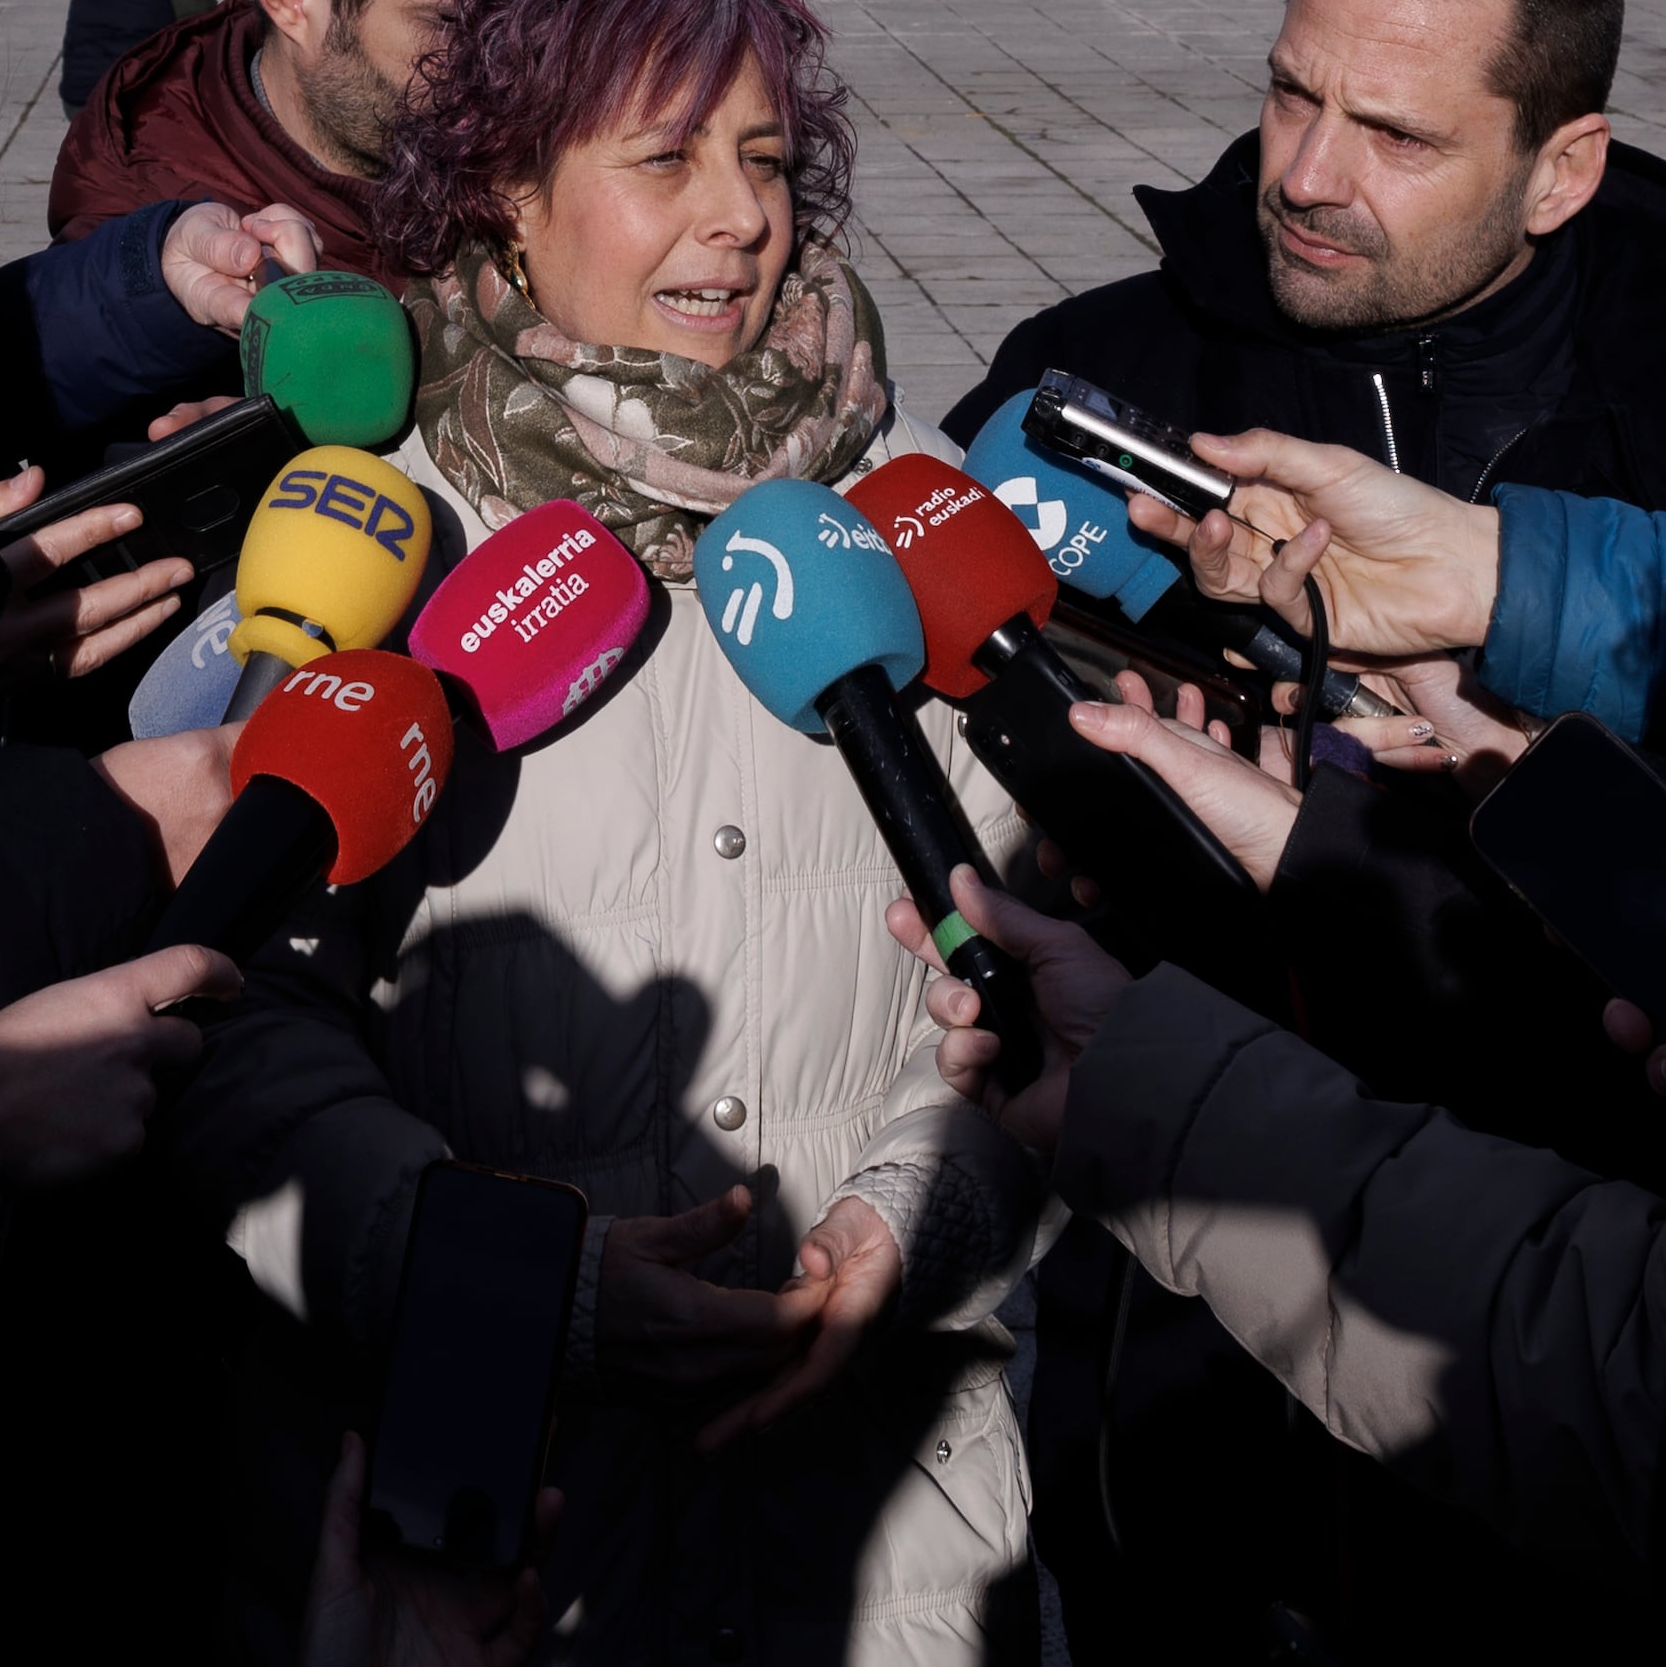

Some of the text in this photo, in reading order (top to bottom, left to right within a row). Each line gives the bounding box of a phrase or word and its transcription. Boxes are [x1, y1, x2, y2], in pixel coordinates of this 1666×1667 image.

[269, 470, 414, 562] SER
[915, 487, 956, 517] radio
[929, 487, 986, 527] euskadi
[1048, 520, 1107, 576] COPE
[461, 529, 596, 653] euskalerria
[510, 573, 590, 643] irratia
[283, 670, 376, 712] rne
[399, 722, 436, 823] rne
